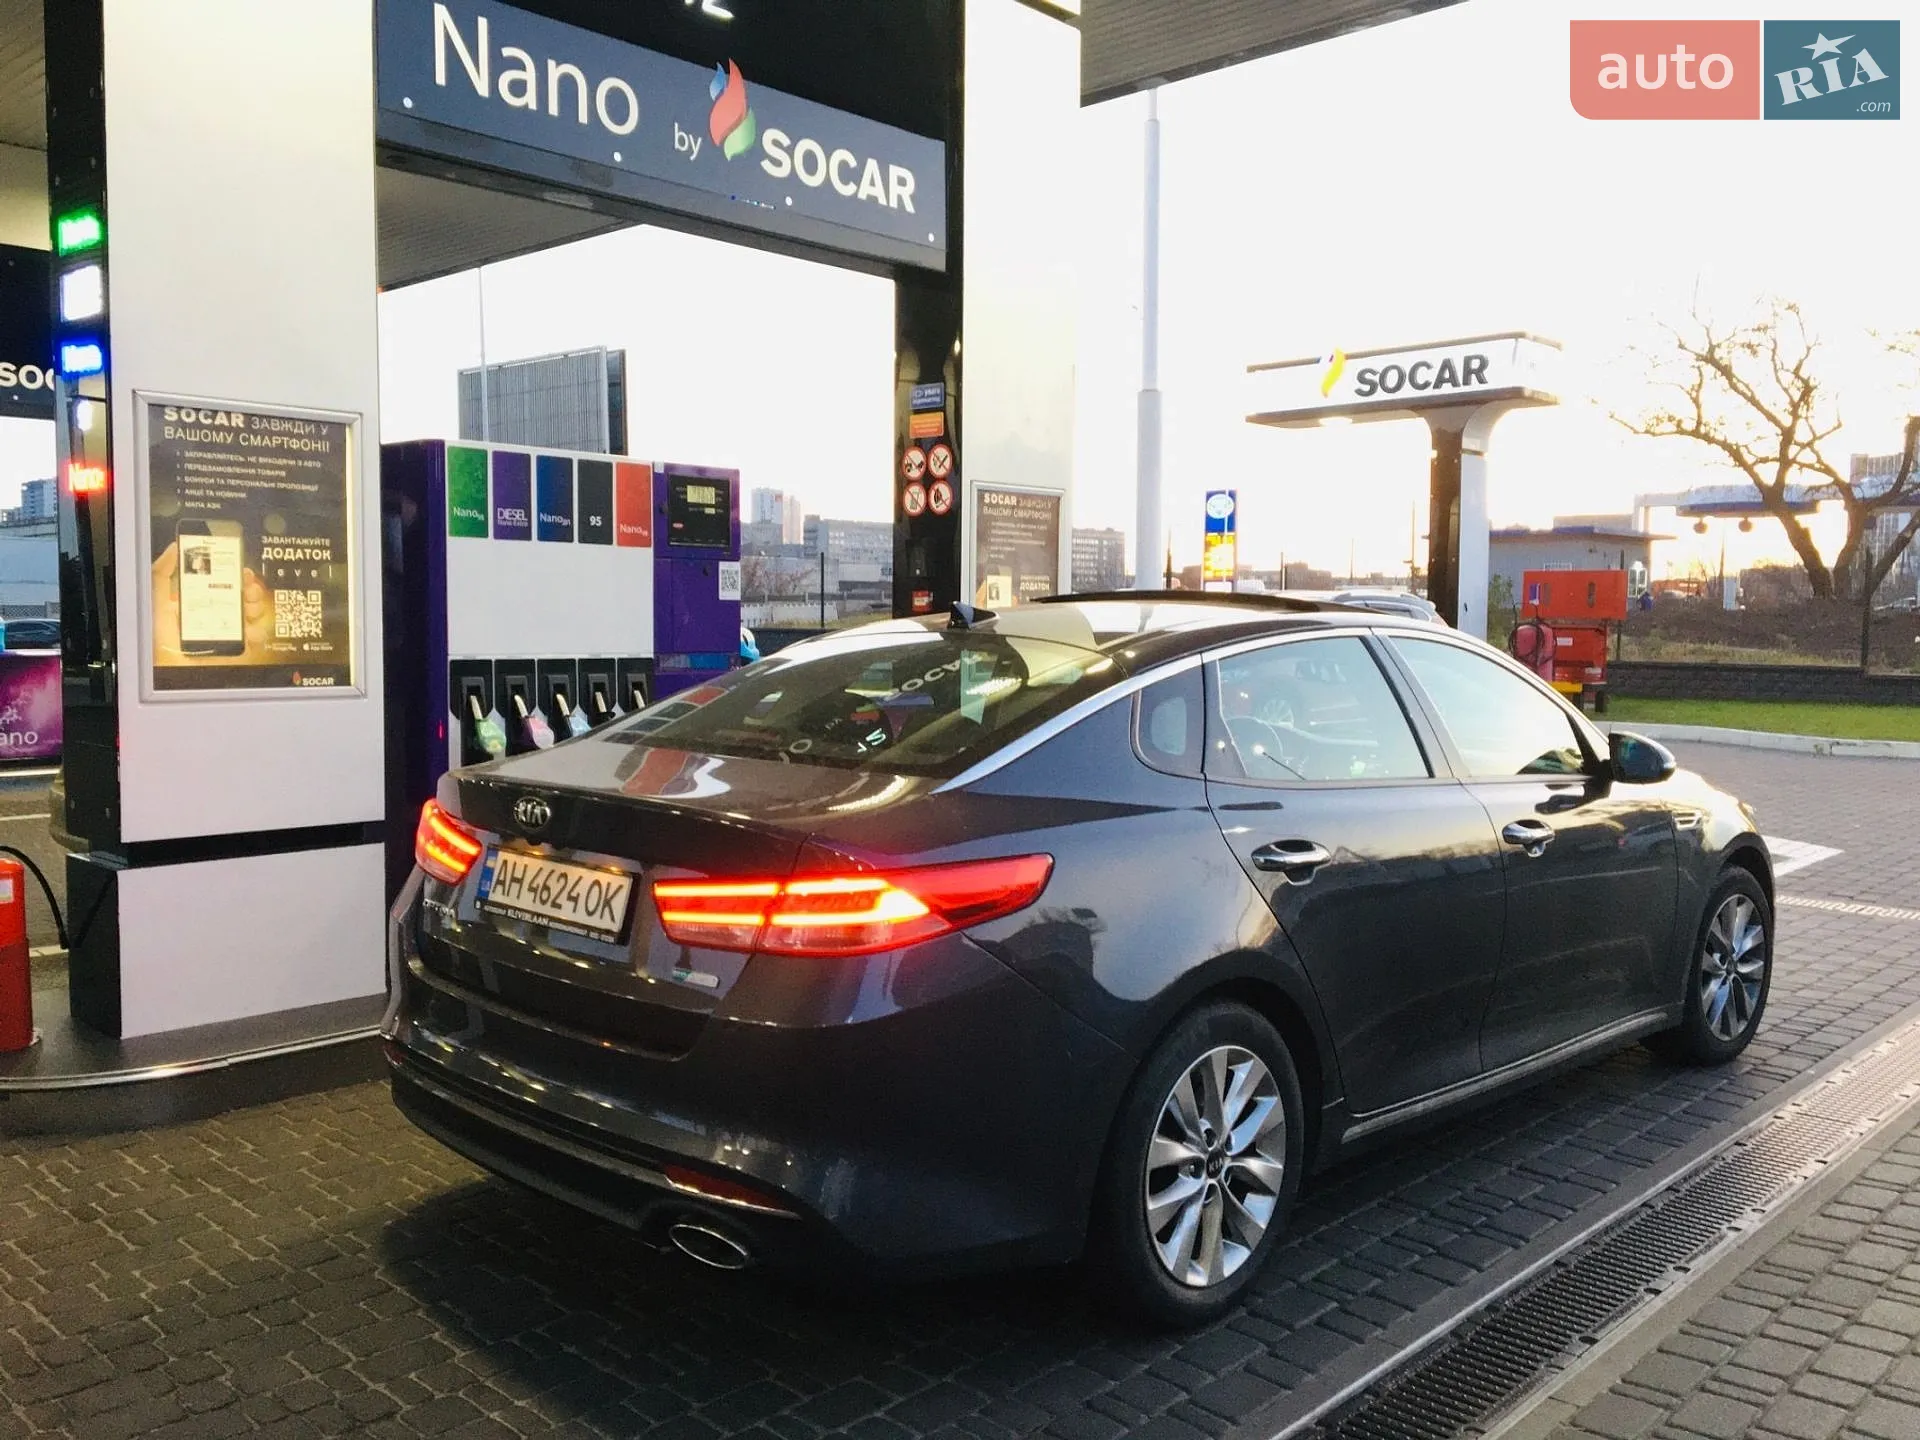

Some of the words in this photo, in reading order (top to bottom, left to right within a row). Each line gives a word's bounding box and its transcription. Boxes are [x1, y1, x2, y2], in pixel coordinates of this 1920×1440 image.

[433, 2, 639, 136] Nano
[674, 122, 702, 162] by
[760, 128, 915, 214] SOCAR
[1354, 353, 1489, 397] SOCAR
[164, 407, 245, 428] SOCAR
[251, 416, 315, 435] ЗАВЖДИ
[164, 426, 233, 444] ВАШОМУ
[983, 492, 1017, 506] SOCAR
[497, 507, 529, 520] DIESEL
[589, 515, 602, 527] 95
[262, 536, 331, 547] ЗАВАНТАЖУЙТЕ
[262, 547, 331, 561] ДОДАТОК
[302, 677, 335, 686] SOCAR
[528, 867, 582, 913] 4624
